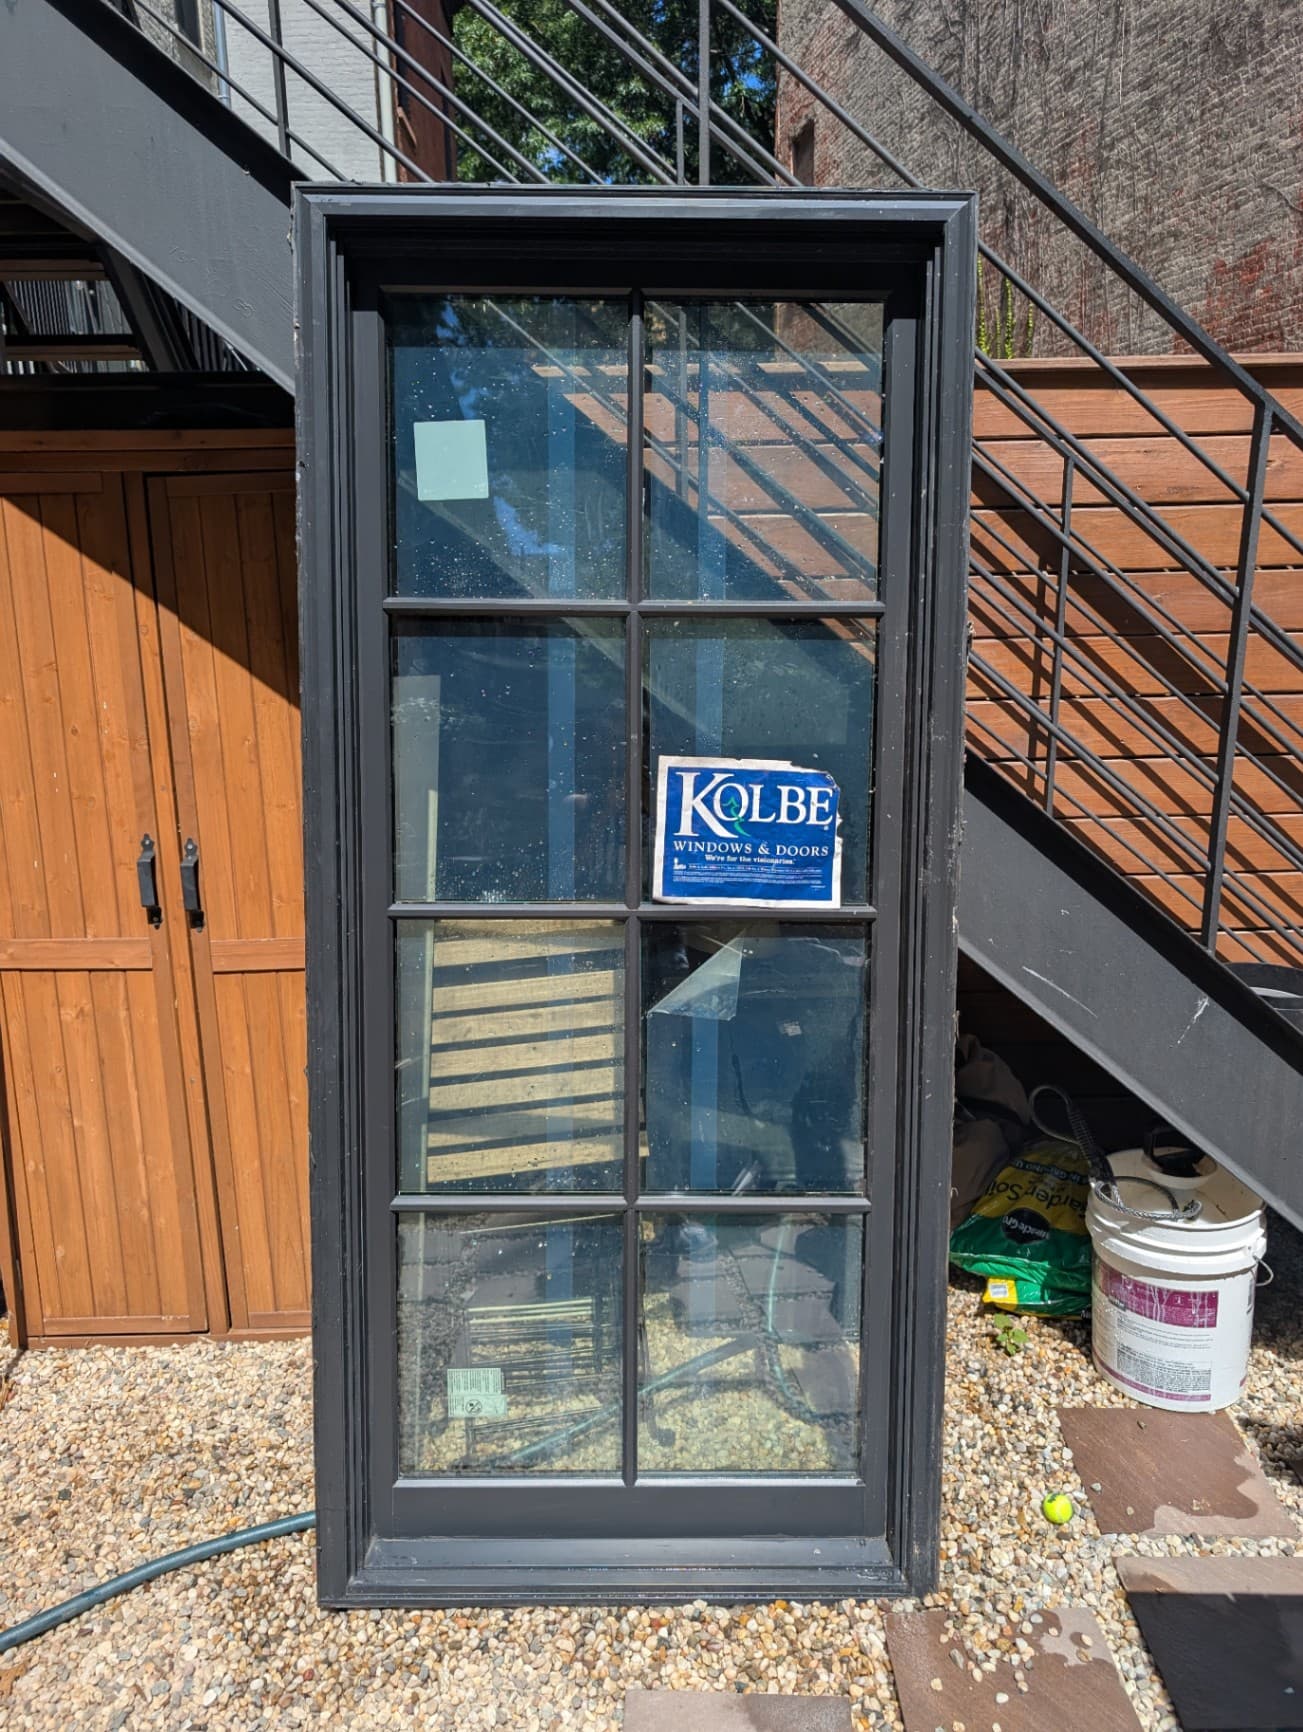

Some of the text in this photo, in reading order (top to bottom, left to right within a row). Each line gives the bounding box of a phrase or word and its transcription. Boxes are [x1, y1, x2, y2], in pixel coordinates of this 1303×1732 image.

[673, 772, 833, 838] KOLBE
[673, 840, 829, 857] WINDOWS & DOORS
[739, 855, 752, 863] the
